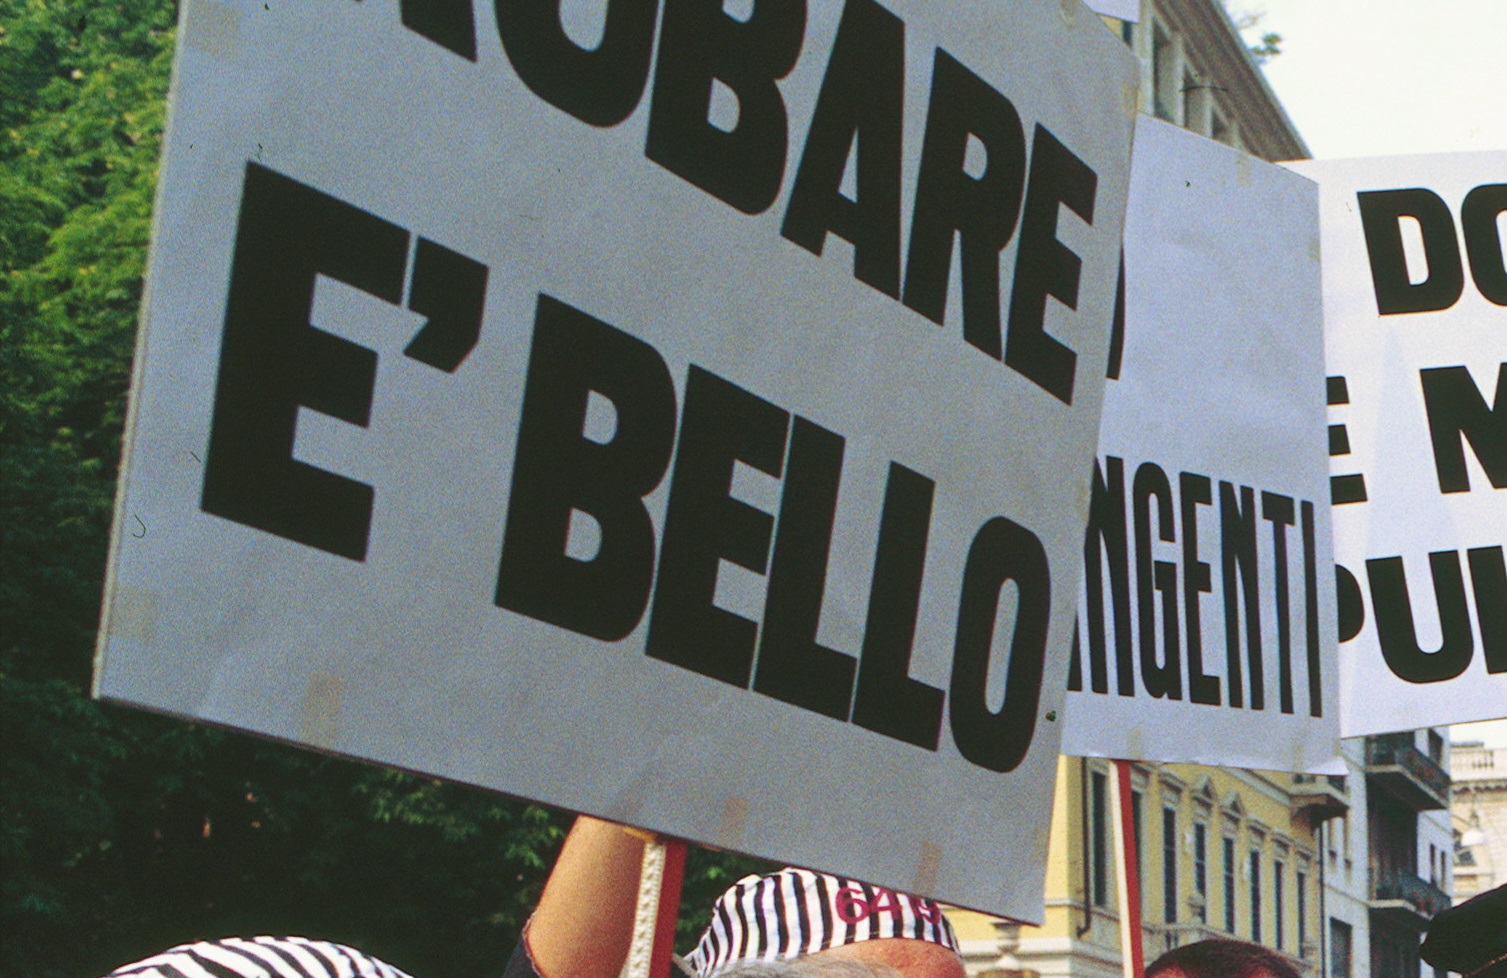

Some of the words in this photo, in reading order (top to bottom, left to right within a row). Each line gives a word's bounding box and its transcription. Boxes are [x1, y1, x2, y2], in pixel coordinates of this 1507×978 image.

[400, 0, 1097, 406] BARE
[201, 160, 489, 563] E'
[494, 292, 1052, 773] BELLO
[1067, 454, 1322, 718] NGENTI
